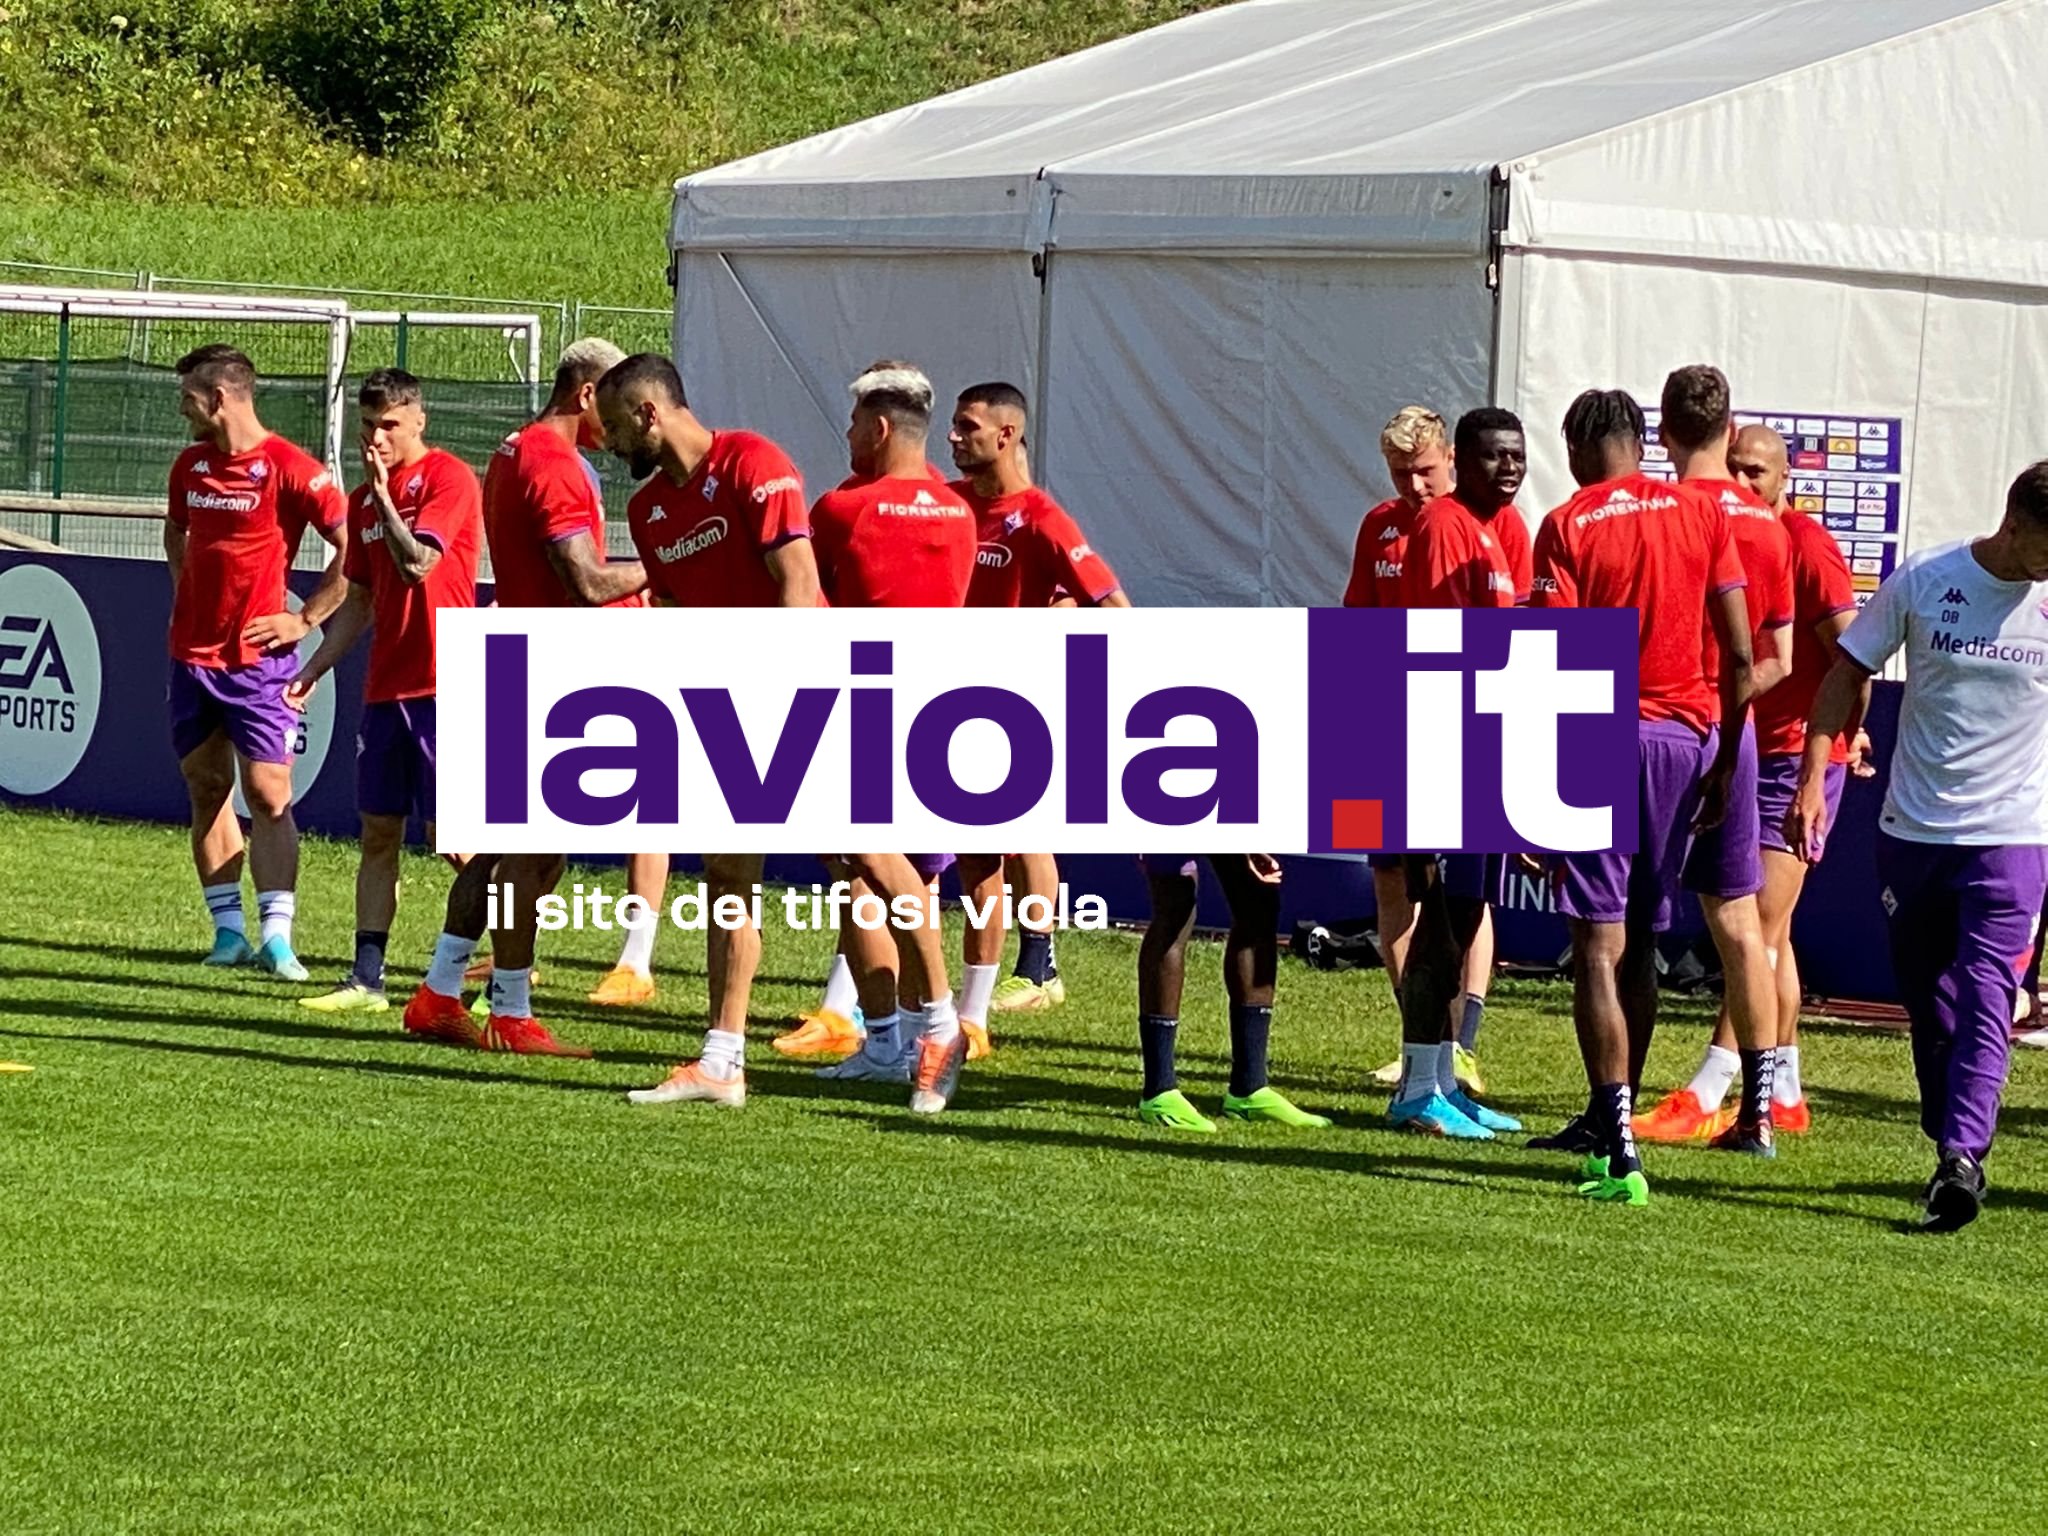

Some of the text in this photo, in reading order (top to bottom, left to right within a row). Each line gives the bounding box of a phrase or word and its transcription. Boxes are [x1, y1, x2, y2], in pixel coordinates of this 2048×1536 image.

[186, 490, 251, 512] Mediacom
[877, 502, 967, 518] FIORENTINA
[1575, 494, 1678, 528] FIORENTINA
[654, 525, 723, 565] Mediacom
[0, 615, 75, 694] EA
[1930, 630, 2044, 666] Mediacom
[0, 694, 75, 733] PORTS
